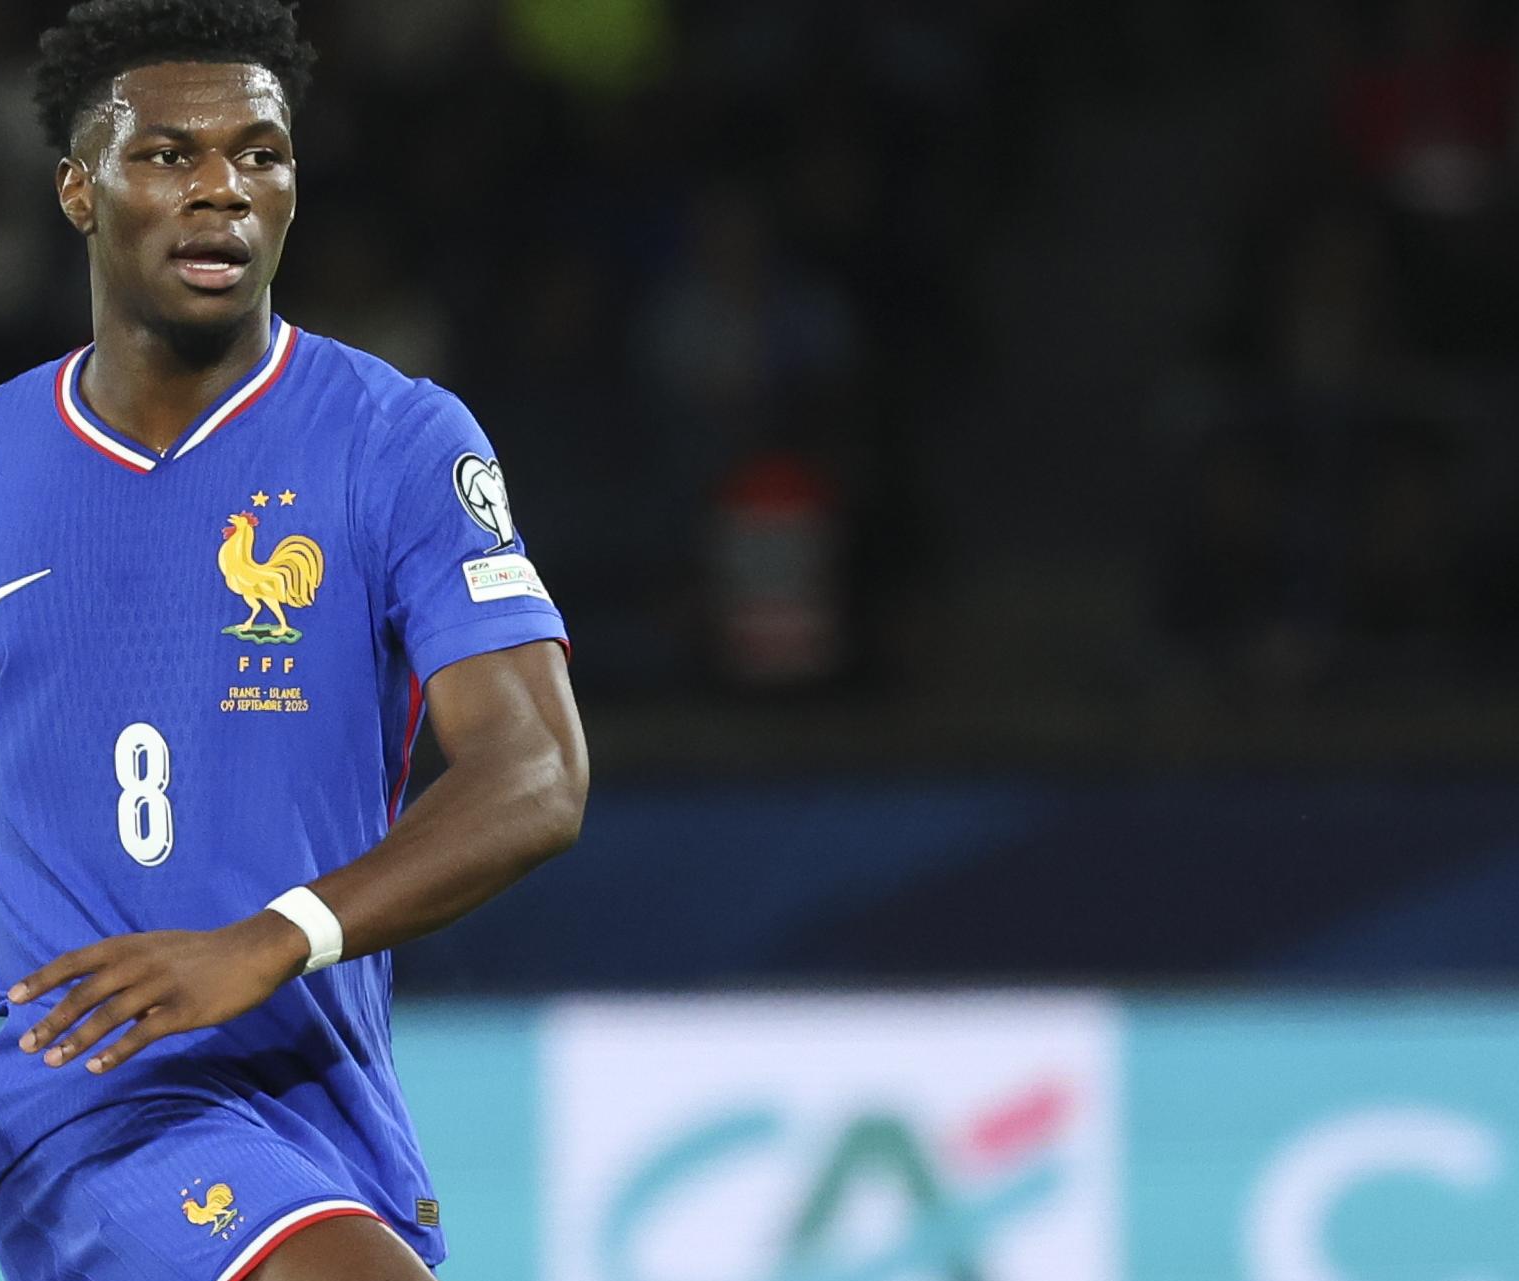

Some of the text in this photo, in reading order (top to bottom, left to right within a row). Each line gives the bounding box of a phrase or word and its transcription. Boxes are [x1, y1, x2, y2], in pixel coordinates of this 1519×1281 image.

[467, 561, 489, 571] UEFA
[229, 687, 261, 699] FRANCE
[220, 699, 309, 712] 09 SEPTEMBRE 2025
[114, 722, 174, 867] 8
